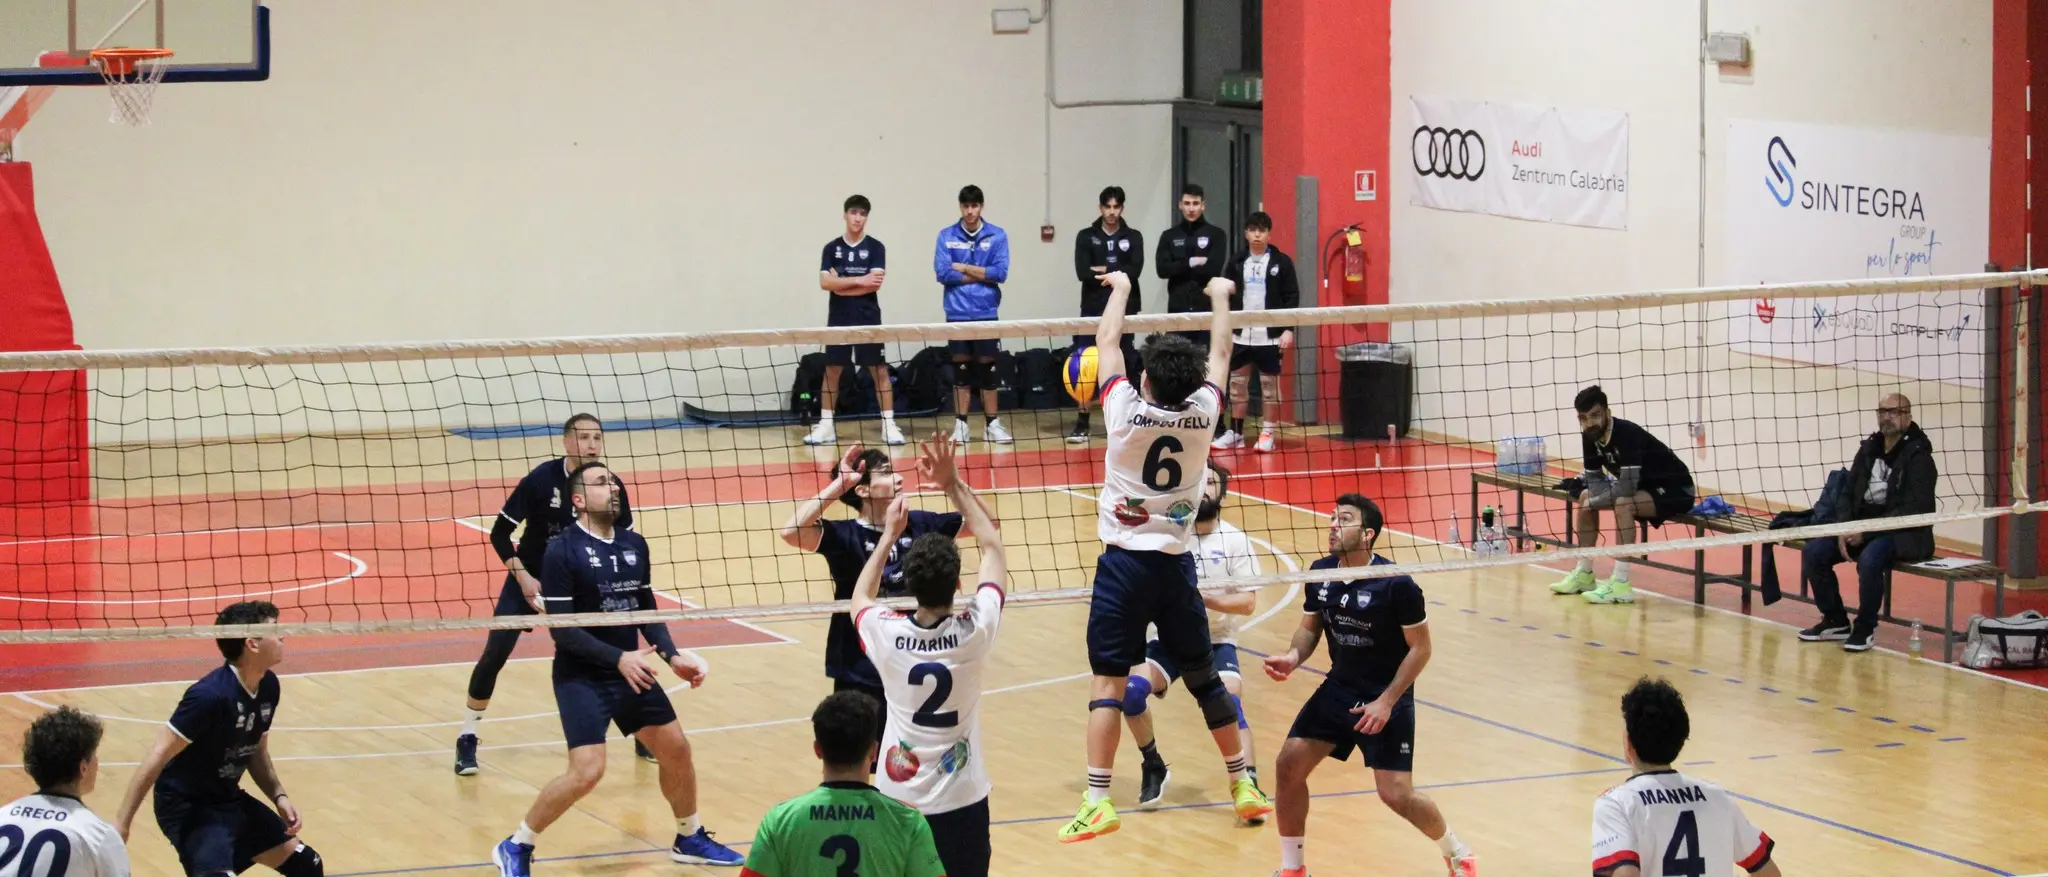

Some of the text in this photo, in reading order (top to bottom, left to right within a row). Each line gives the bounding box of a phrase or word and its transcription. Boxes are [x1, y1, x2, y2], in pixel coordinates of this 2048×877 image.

[1511, 139, 1543, 158] Audi
[1512, 164, 1625, 192] Zentrum Calabria
[1800, 180, 1925, 222] SINTEGRA
[1899, 224, 1927, 240] GROUP
[1142, 435, 1184, 492] 6
[895, 633, 959, 653] GUARINI
[907, 661, 959, 729] 2
[1639, 785, 1707, 806] MANNA
[10, 806, 68, 822] GRECO
[810, 804, 876, 821] MANNA
[1662, 810, 1706, 877] 4
